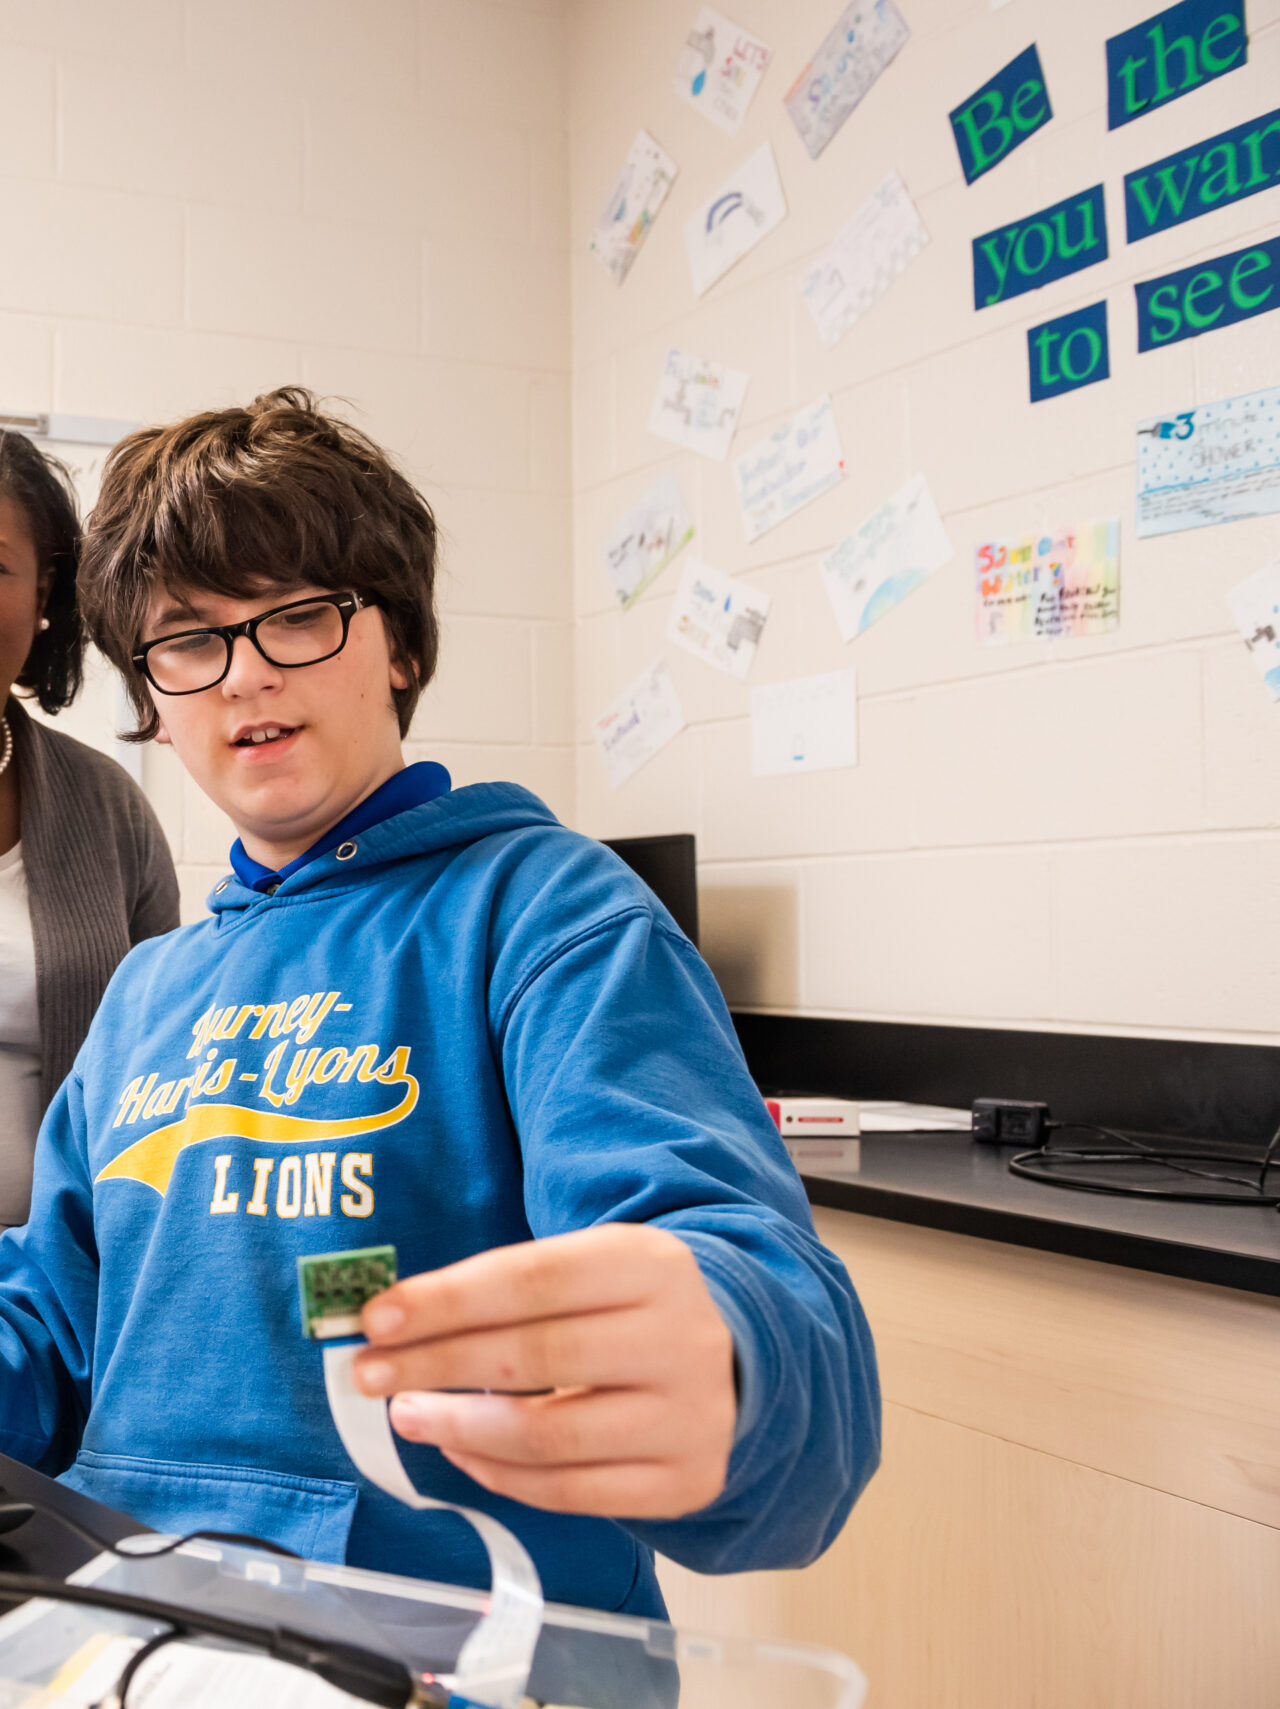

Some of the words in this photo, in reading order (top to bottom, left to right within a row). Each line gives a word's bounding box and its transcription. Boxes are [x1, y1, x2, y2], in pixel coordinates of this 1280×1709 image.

[953, 79, 1047, 178] Be
[1117, 13, 1242, 115] the
[981, 199, 1099, 307] you
[1035, 326, 1102, 386] to
[1148, 250, 1275, 343] see
[1175, 410, 1197, 440] 3
[210, 1152, 375, 1219] LIONS
